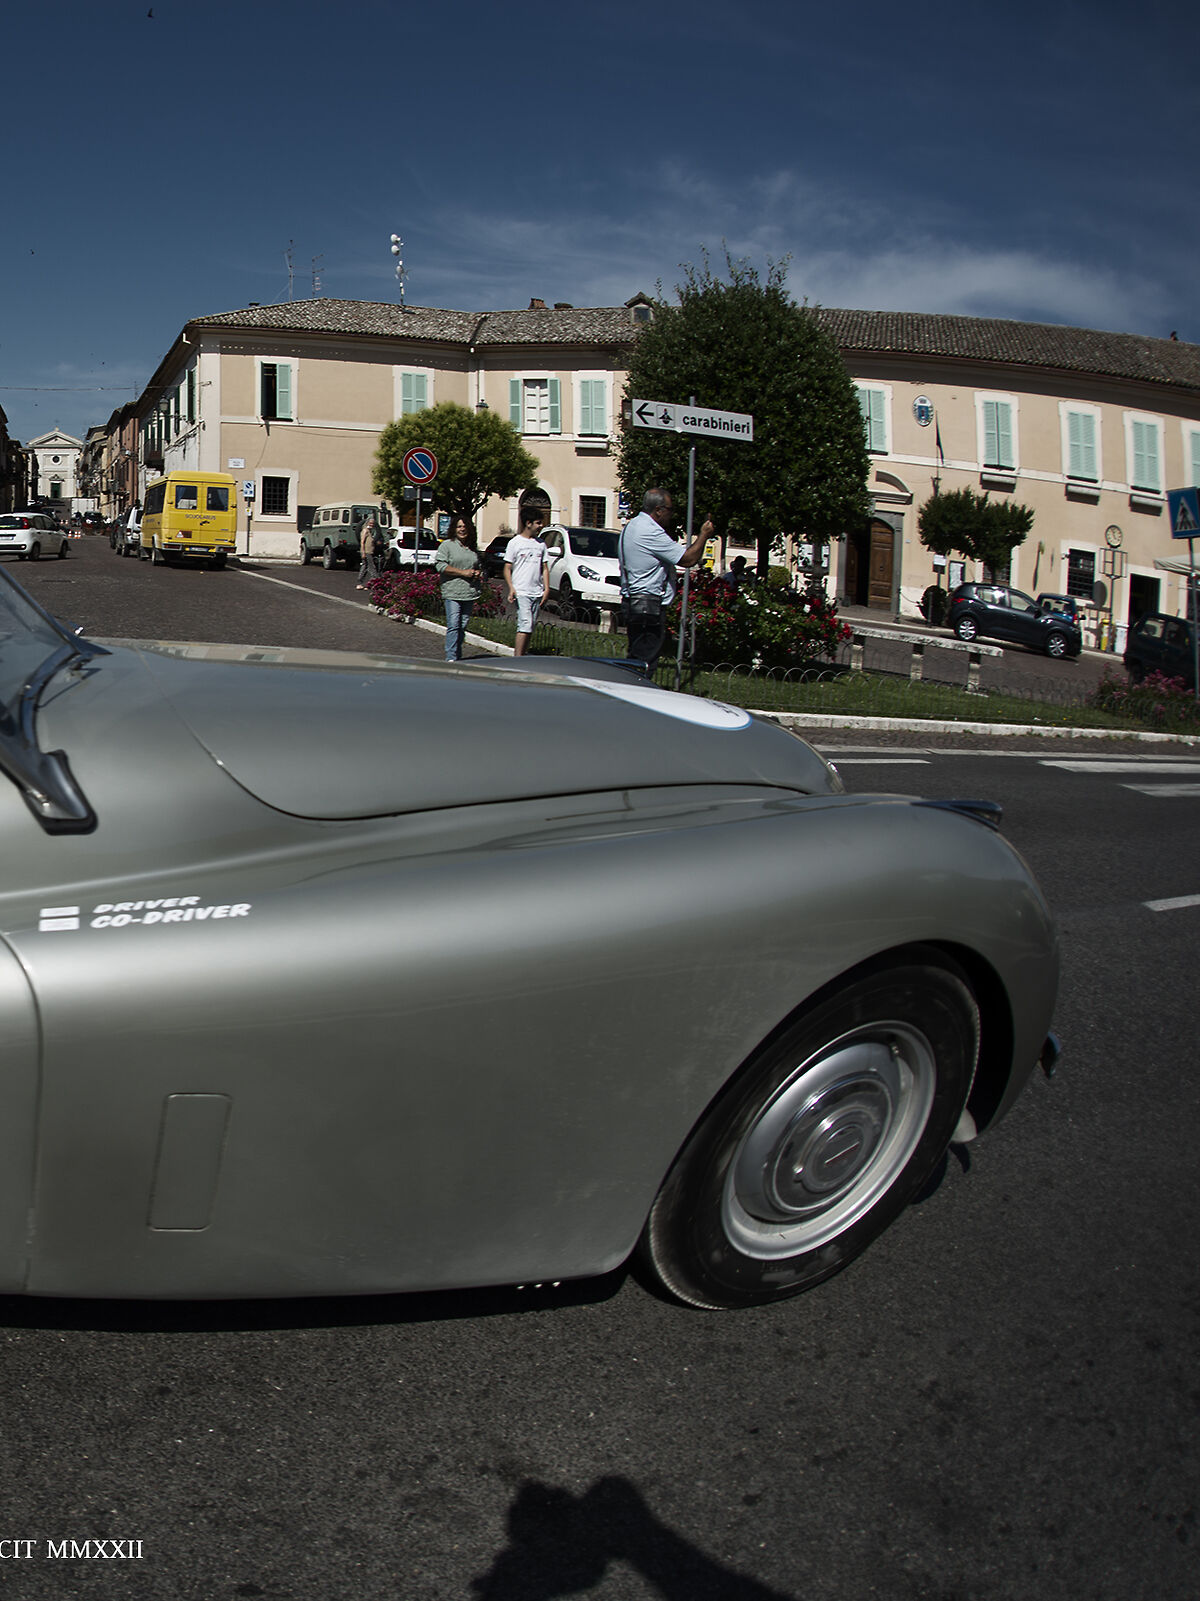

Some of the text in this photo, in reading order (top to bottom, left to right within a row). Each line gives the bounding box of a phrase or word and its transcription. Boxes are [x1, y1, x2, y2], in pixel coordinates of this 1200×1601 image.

[683, 415, 750, 434] carabinieri
[92, 895, 201, 914] DRIVER
[89, 903, 253, 929] CO-DRIVER
